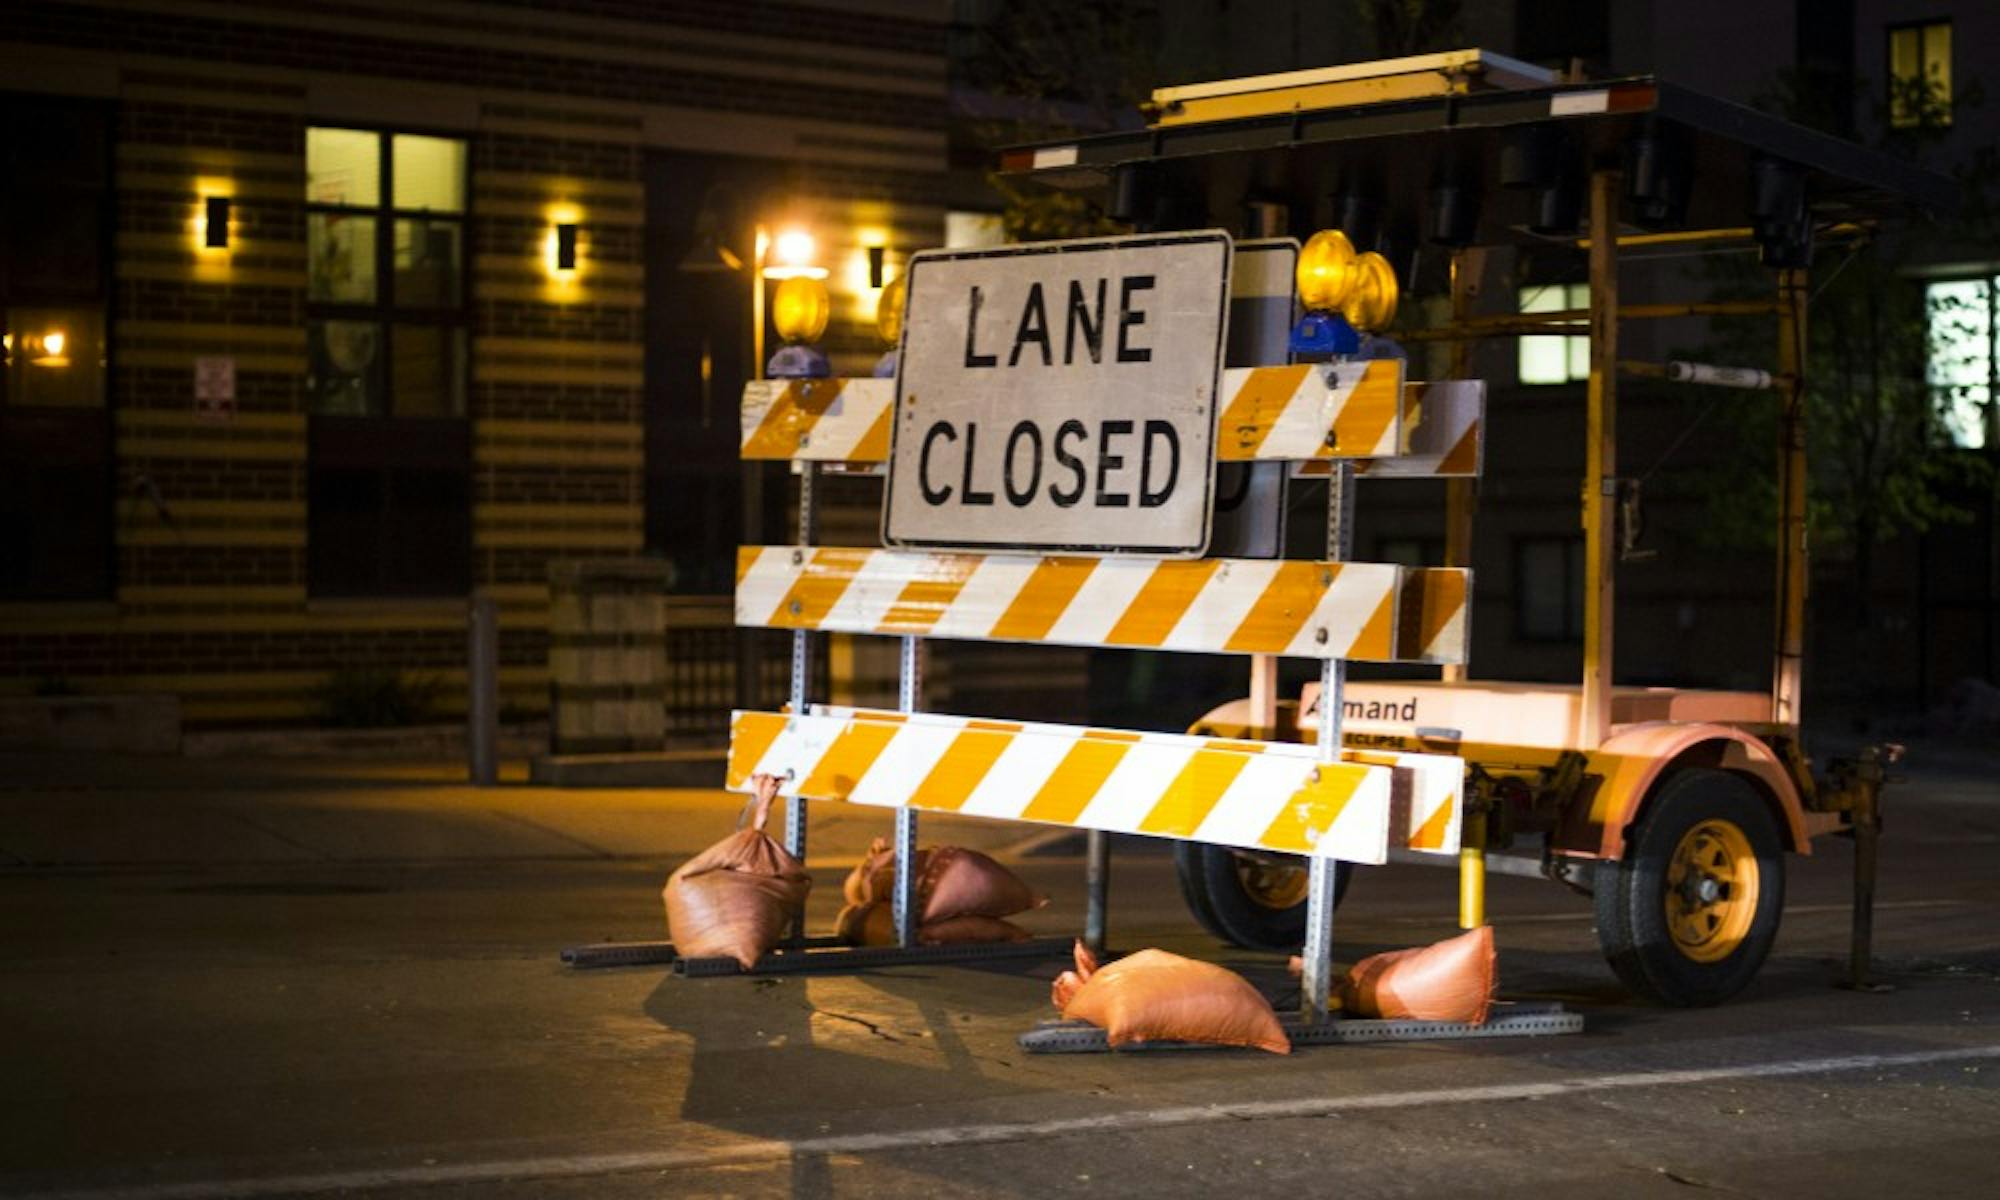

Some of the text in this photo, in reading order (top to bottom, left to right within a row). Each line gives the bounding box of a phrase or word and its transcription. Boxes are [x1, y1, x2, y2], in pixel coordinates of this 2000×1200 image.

[964, 275, 1156, 368] LANE
[918, 419, 1181, 508] CLOSED
[1305, 694, 1417, 721] Amand
